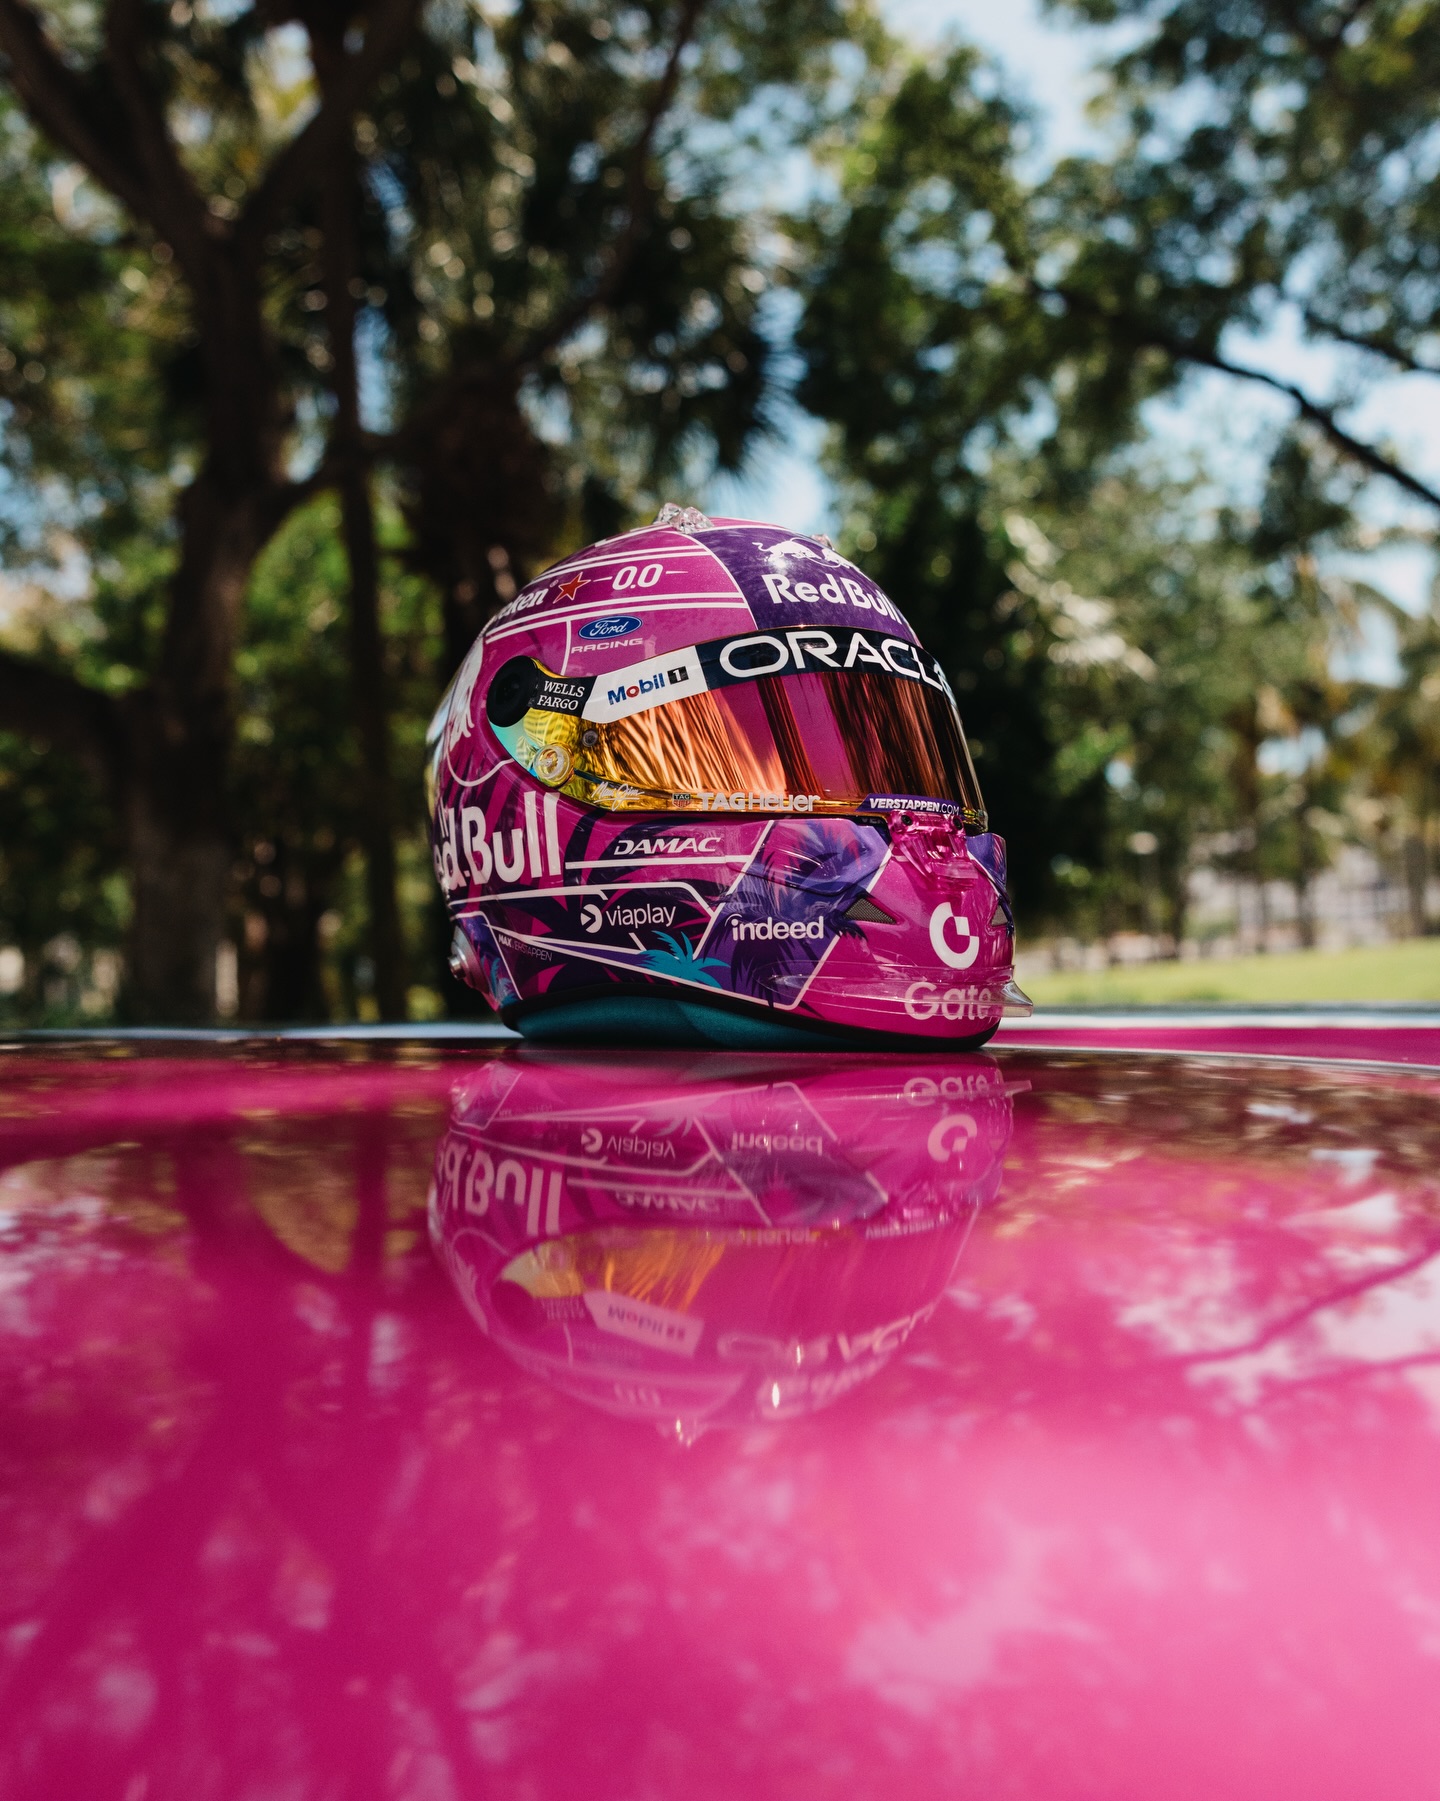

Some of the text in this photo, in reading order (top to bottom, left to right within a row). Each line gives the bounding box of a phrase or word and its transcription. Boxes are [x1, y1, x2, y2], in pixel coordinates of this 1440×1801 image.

[589, 617, 630, 637] Ford
[571, 637, 644, 655] RACING
[543, 680, 586, 699] WELLS
[606, 667, 686, 706] Mobil 1
[536, 695, 580, 712] FARGO
[869, 797, 960, 816] VERSTAPPEN.COM
[613, 836, 721, 856] DAMAC
[605, 904, 677, 929] viaplay
[729, 914, 825, 942] indeed
[498, 933, 512, 948] MAX
[904, 981, 992, 1021] Gate
